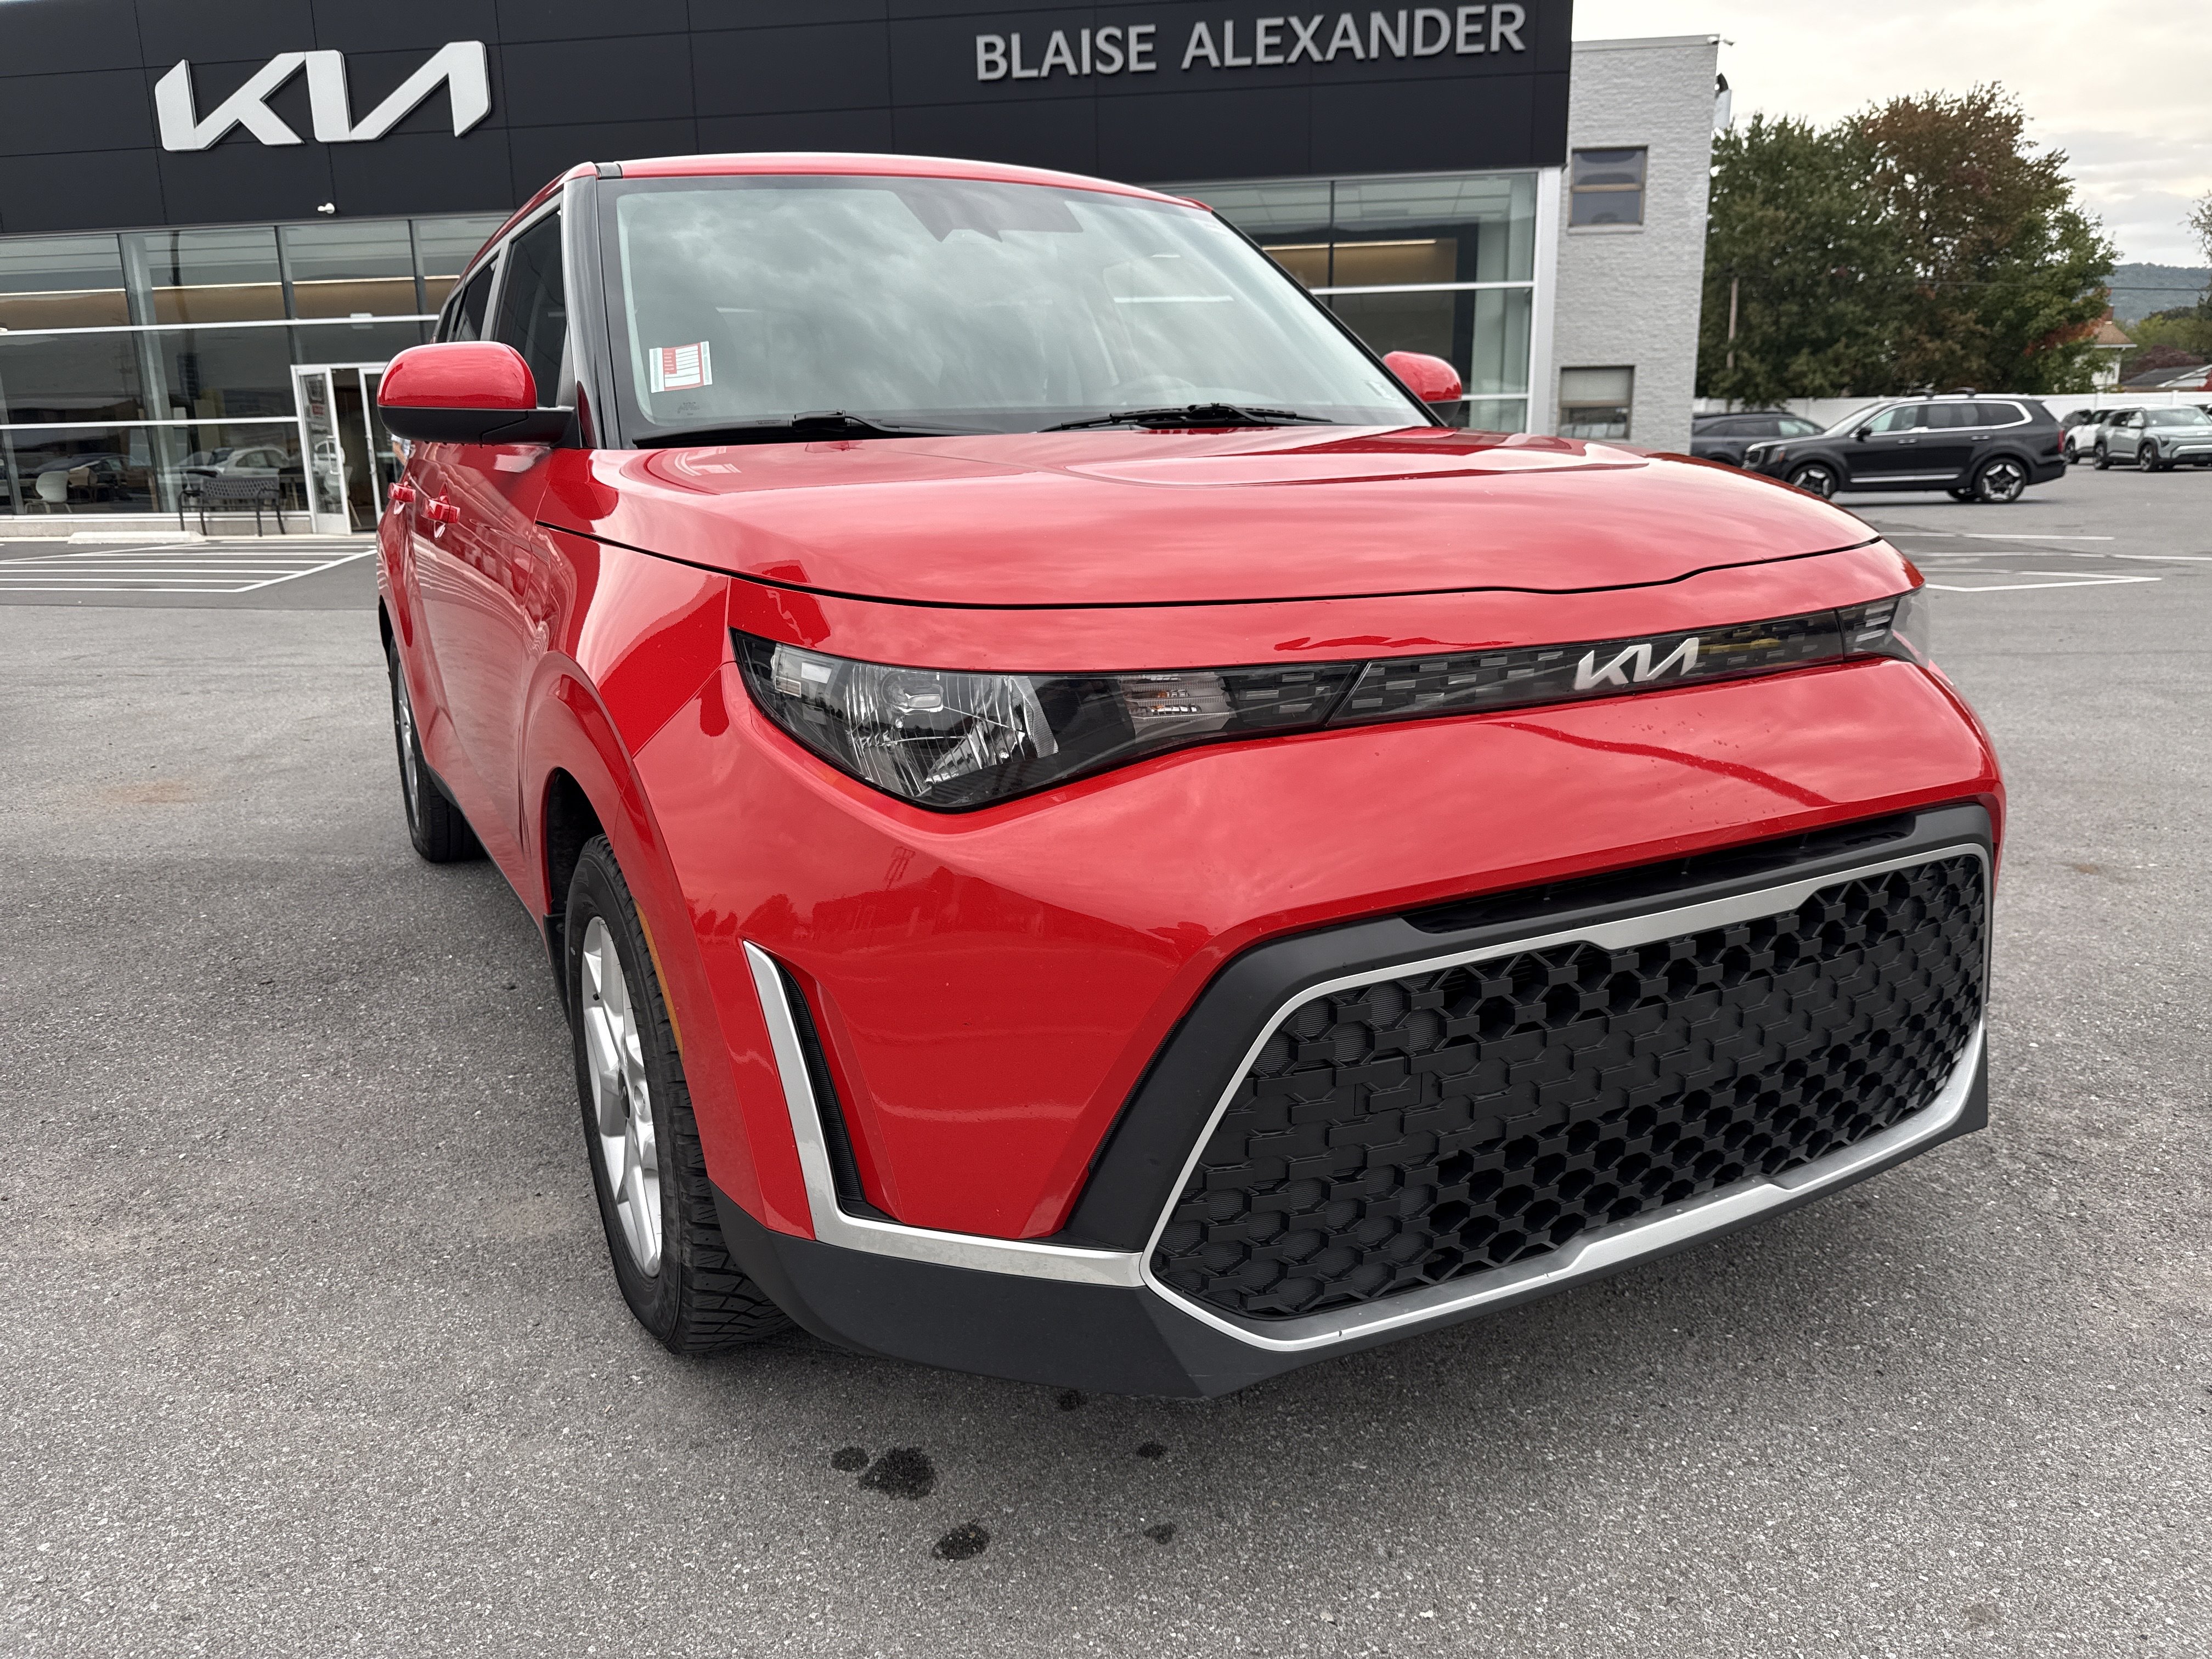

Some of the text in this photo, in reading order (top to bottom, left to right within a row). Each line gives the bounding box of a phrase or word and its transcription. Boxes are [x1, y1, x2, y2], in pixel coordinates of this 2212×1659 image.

[975, 3, 1526, 81] BLAISE ALEXANDER
[155, 40, 492, 152] KIA
[1573, 637, 1699, 690] KIA
